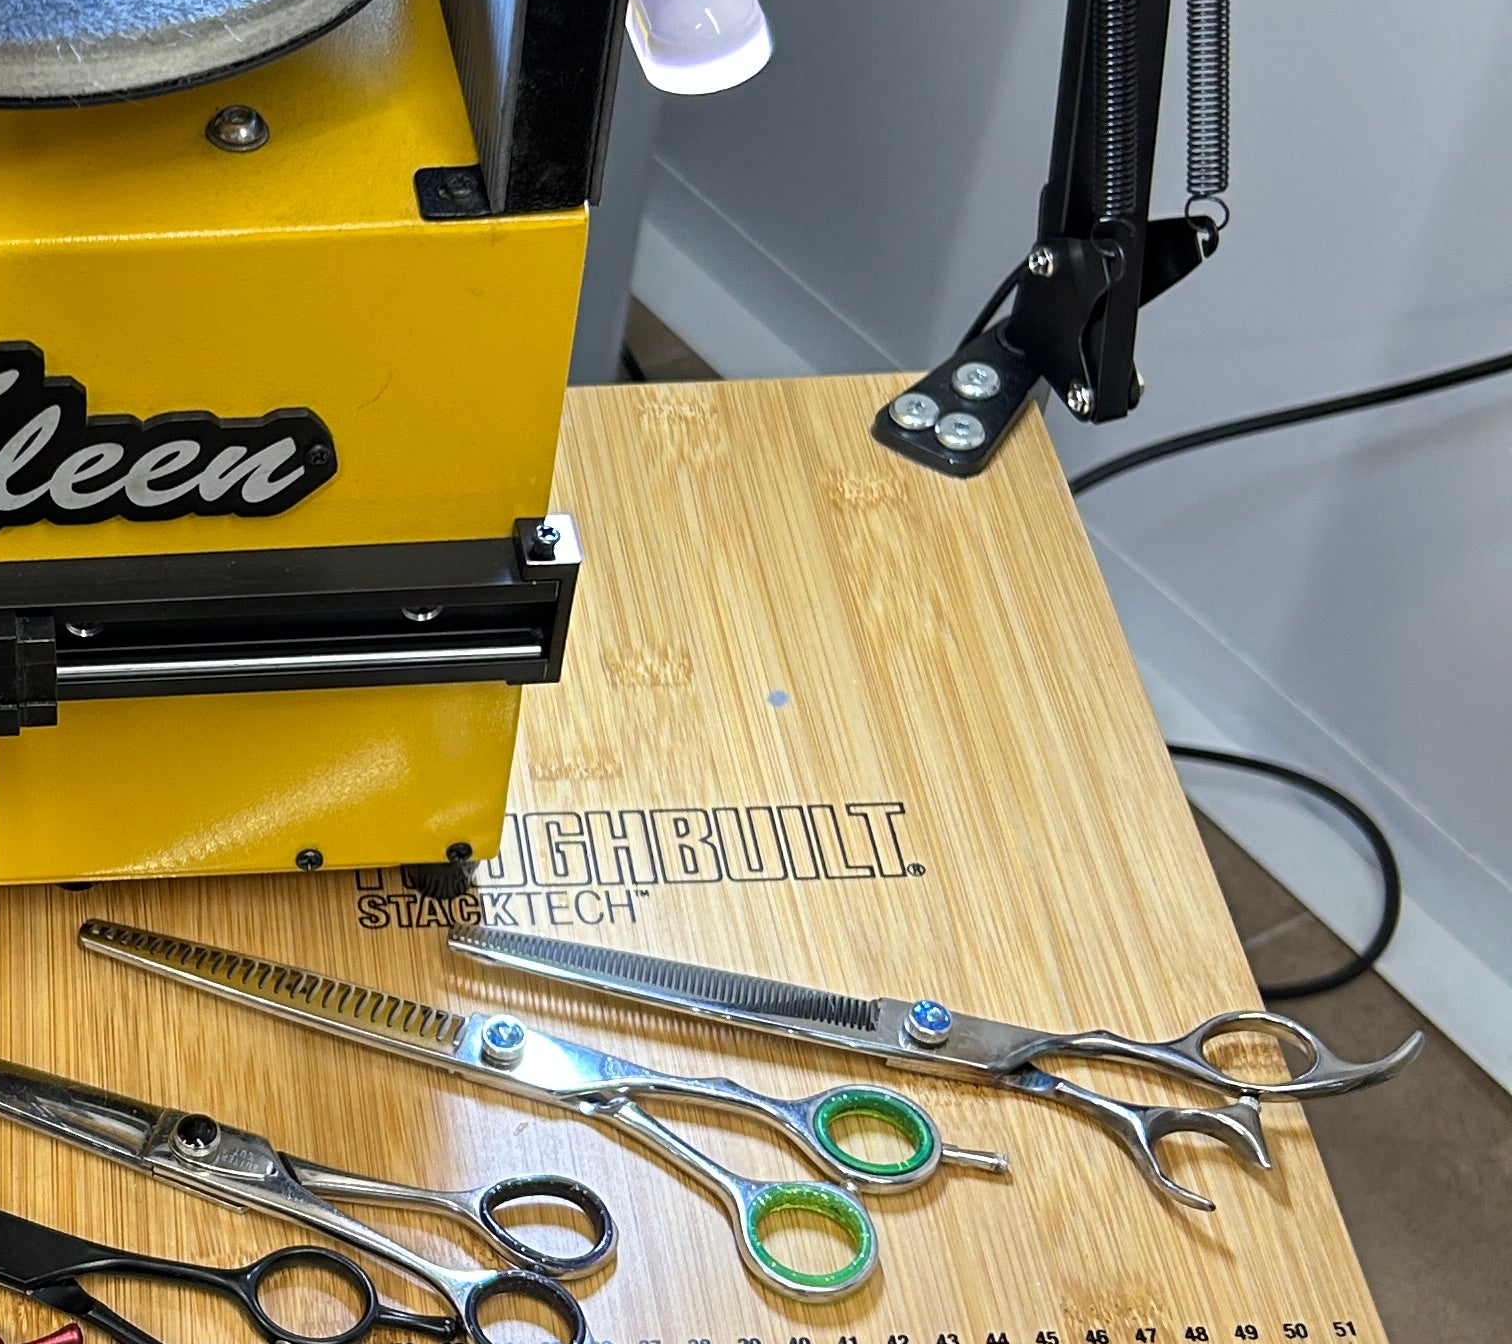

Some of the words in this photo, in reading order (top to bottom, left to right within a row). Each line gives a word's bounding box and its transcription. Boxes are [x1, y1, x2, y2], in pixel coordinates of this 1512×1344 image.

[1135, 1327, 1158, 1344] 47
[1185, 1325, 1209, 1343] 48
[1234, 1324, 1259, 1341] 49
[1284, 1322, 1308, 1340] 50
[1333, 1320, 1357, 1338] 51
